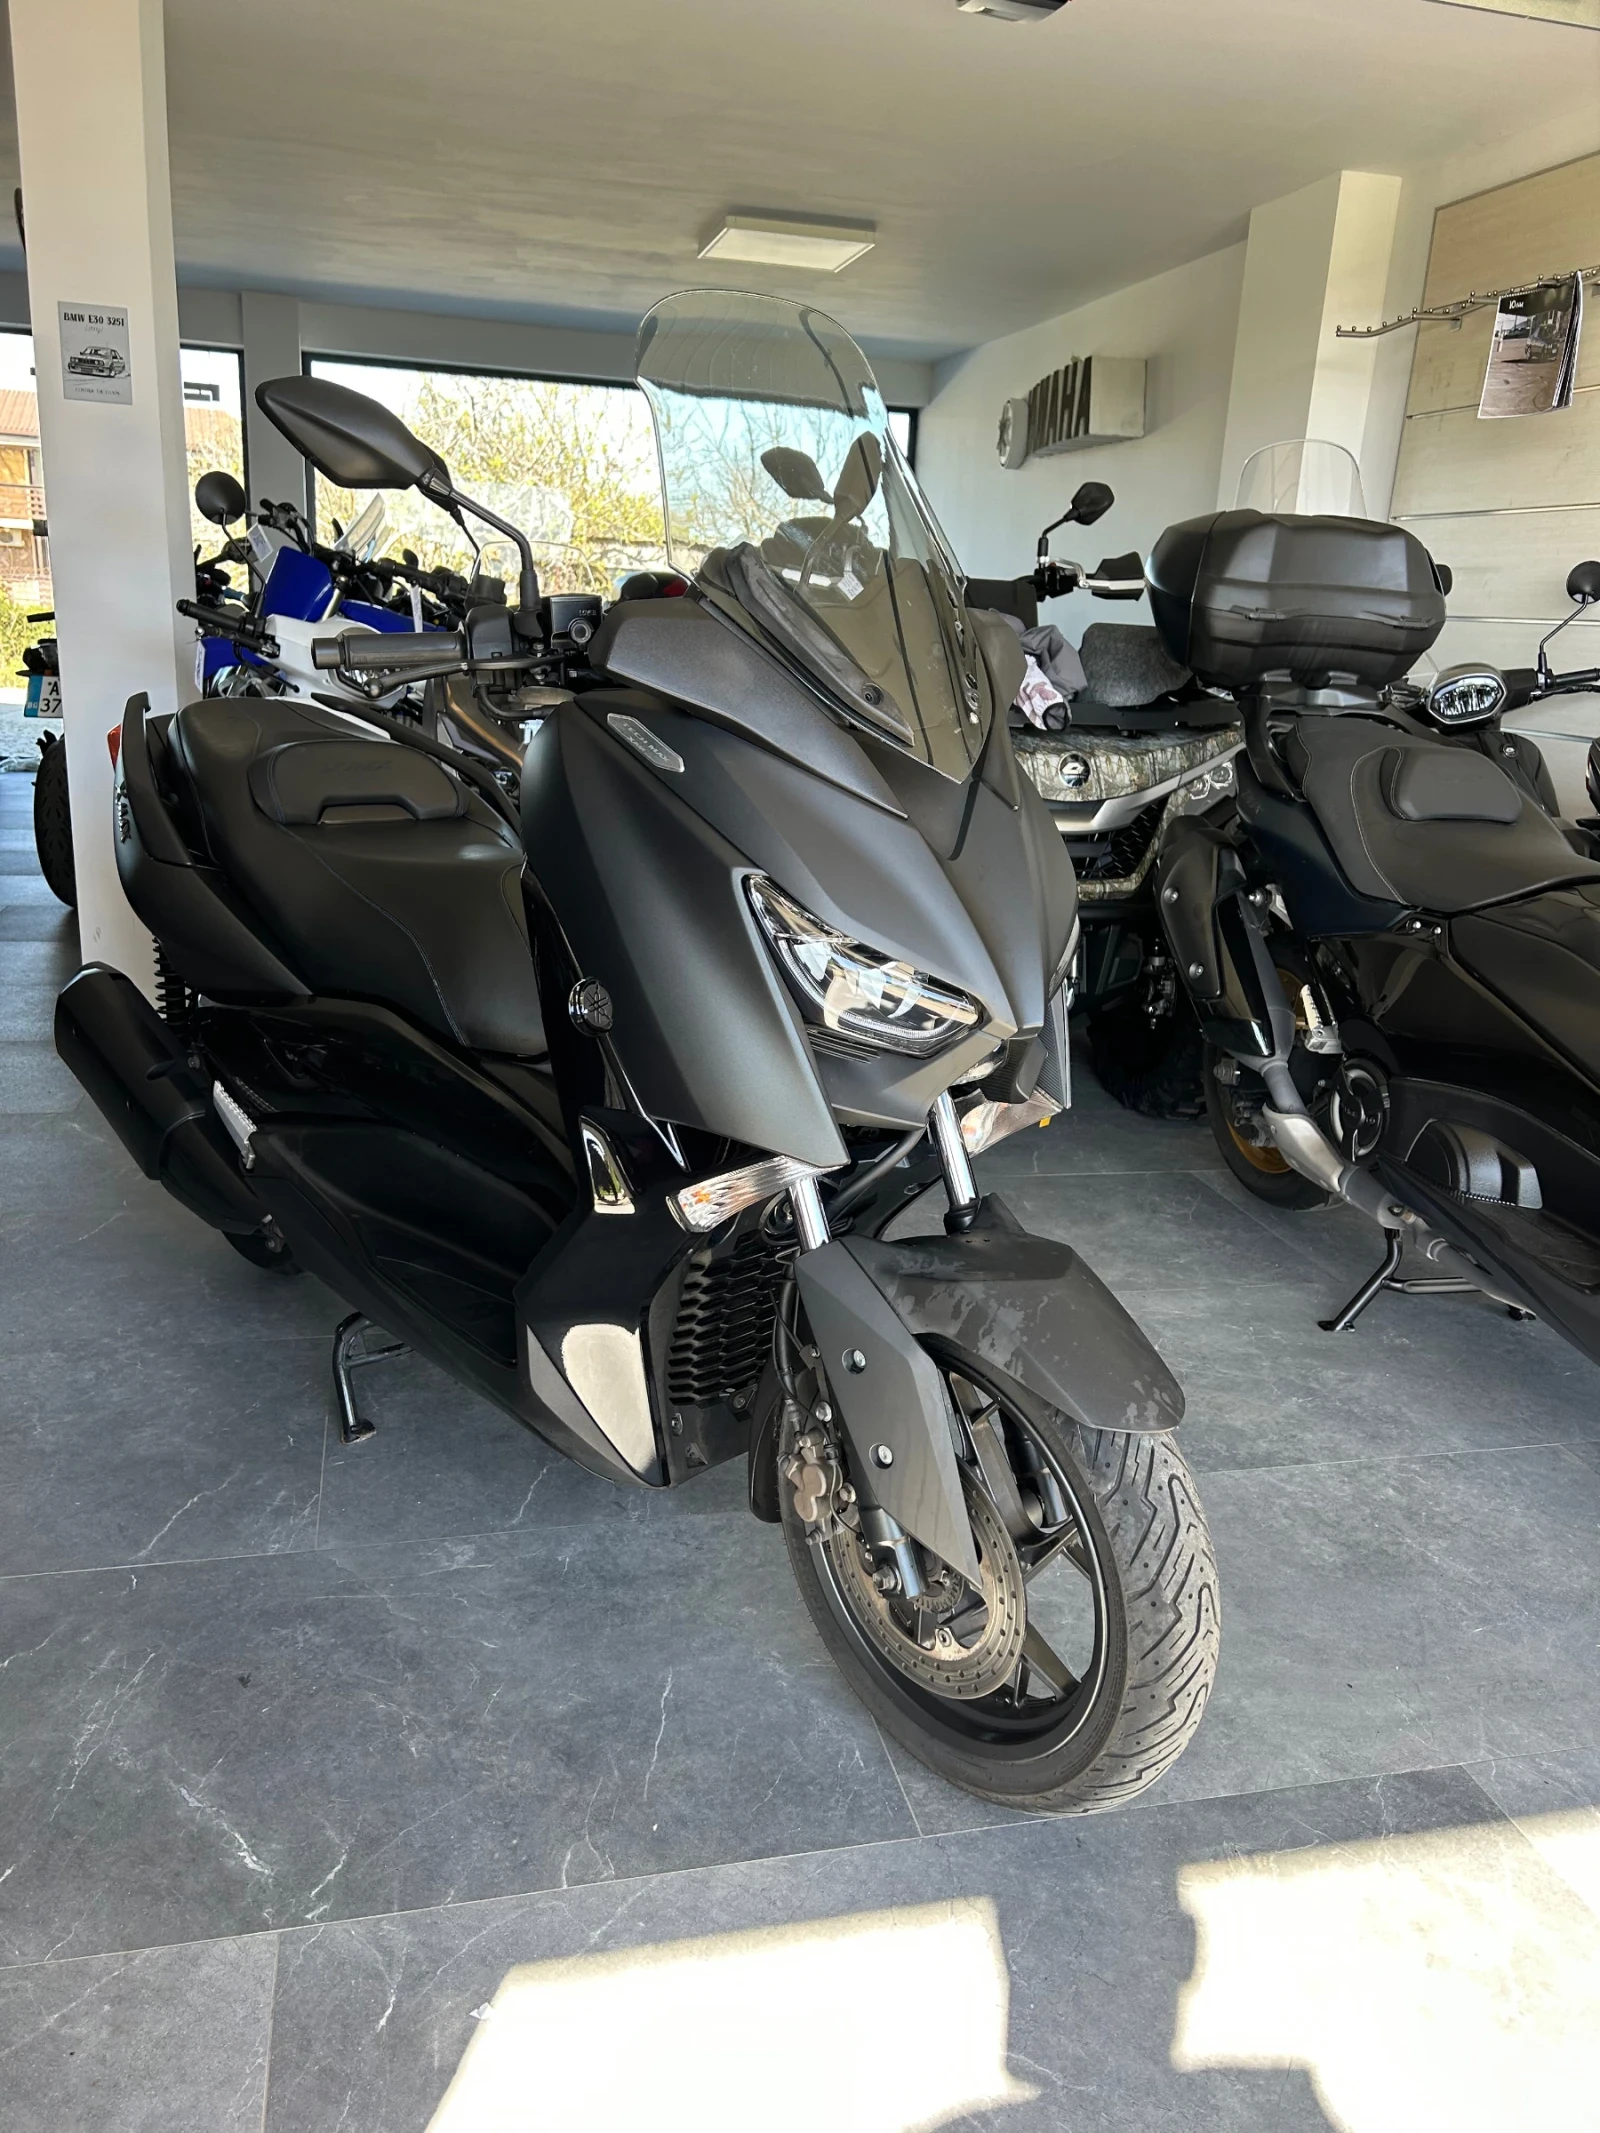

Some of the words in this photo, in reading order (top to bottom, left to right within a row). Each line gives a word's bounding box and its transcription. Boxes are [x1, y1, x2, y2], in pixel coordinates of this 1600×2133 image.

[63, 312, 85, 322] BMW
[88, 314, 104, 324] E30
[648, 744, 670, 763] MAX
